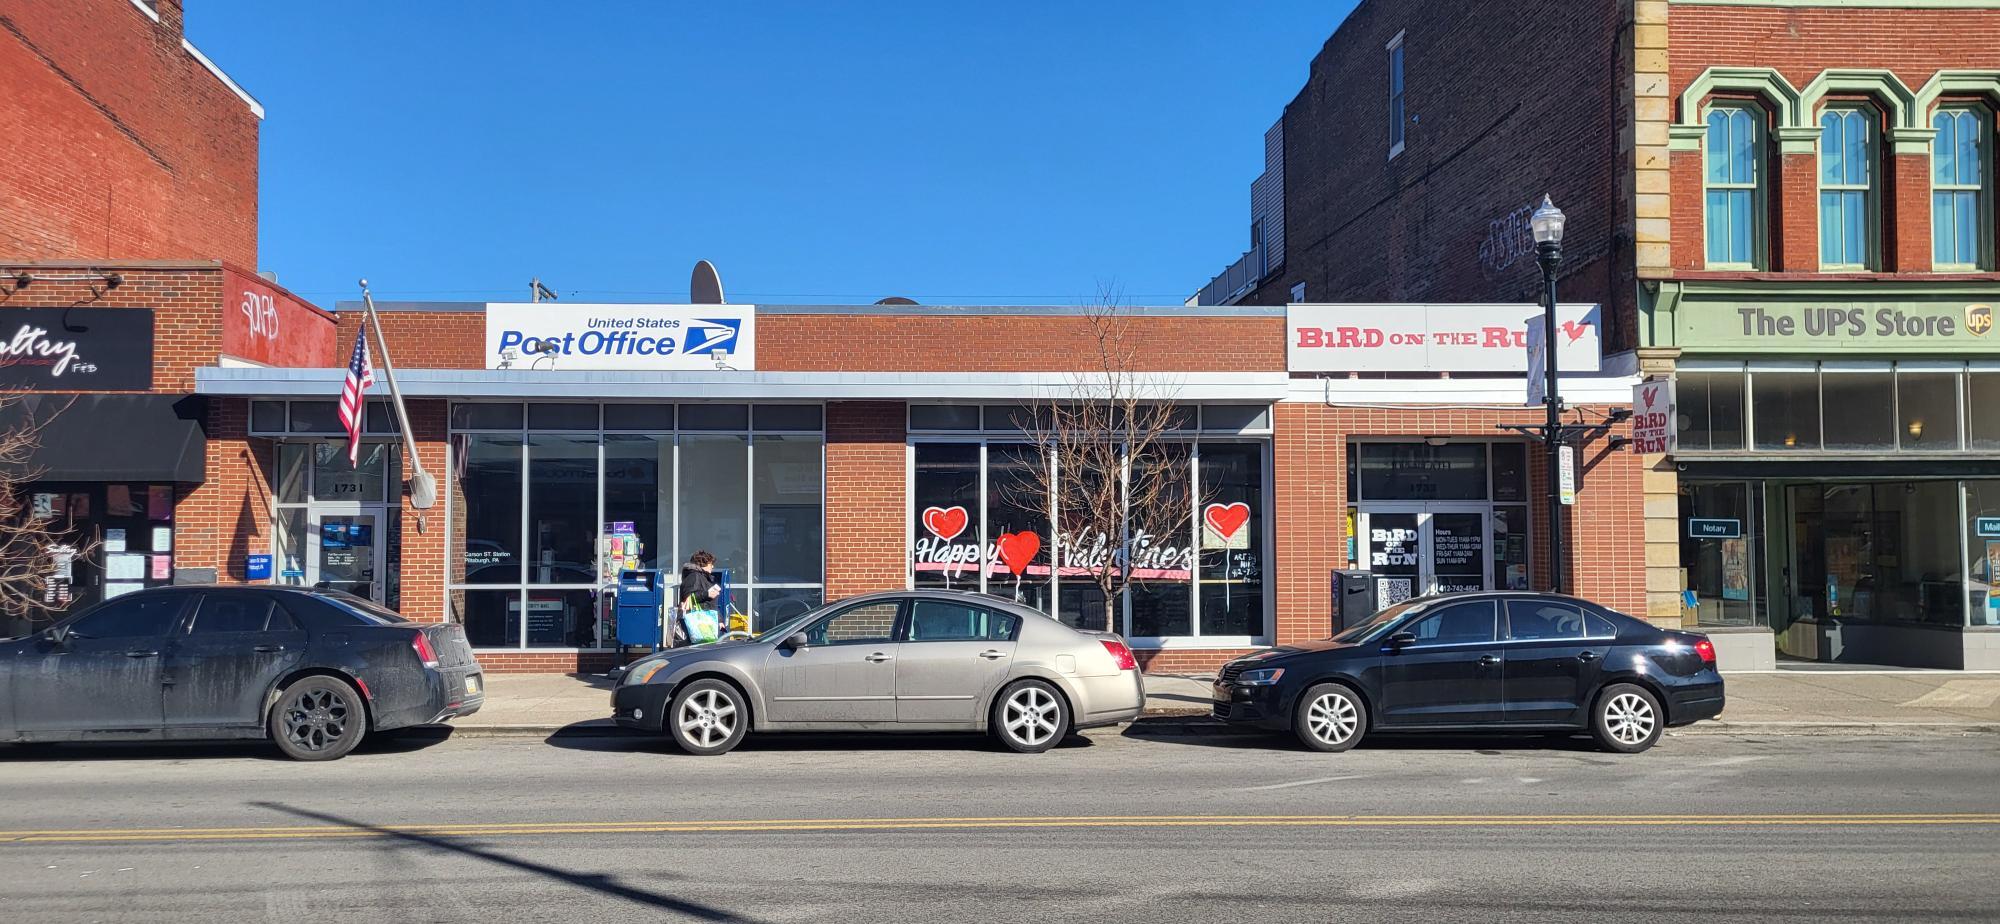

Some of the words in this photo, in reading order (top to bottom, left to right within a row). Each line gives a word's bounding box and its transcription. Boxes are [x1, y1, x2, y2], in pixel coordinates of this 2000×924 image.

[587, 317, 633, 328] United
[636, 317, 680, 328] States
[1738, 308, 1794, 336] The
[1804, 308, 1866, 336] UPS
[1875, 308, 1955, 336] Store
[1967, 312, 1992, 332] ups
[498, 330, 575, 356] Post
[578, 330, 676, 356] Office
[1389, 333, 1425, 345] ON
[1433, 333, 1478, 345] THE
[1482, 327, 1561, 348] RU
[1649, 429, 1665, 437] THE
[1634, 437, 1667, 454] RUN
[334, 483, 363, 493] 1731
[1703, 524, 1727, 534] Notary
[916, 536, 1003, 579] Happy
[1372, 552, 1418, 566] RUN
